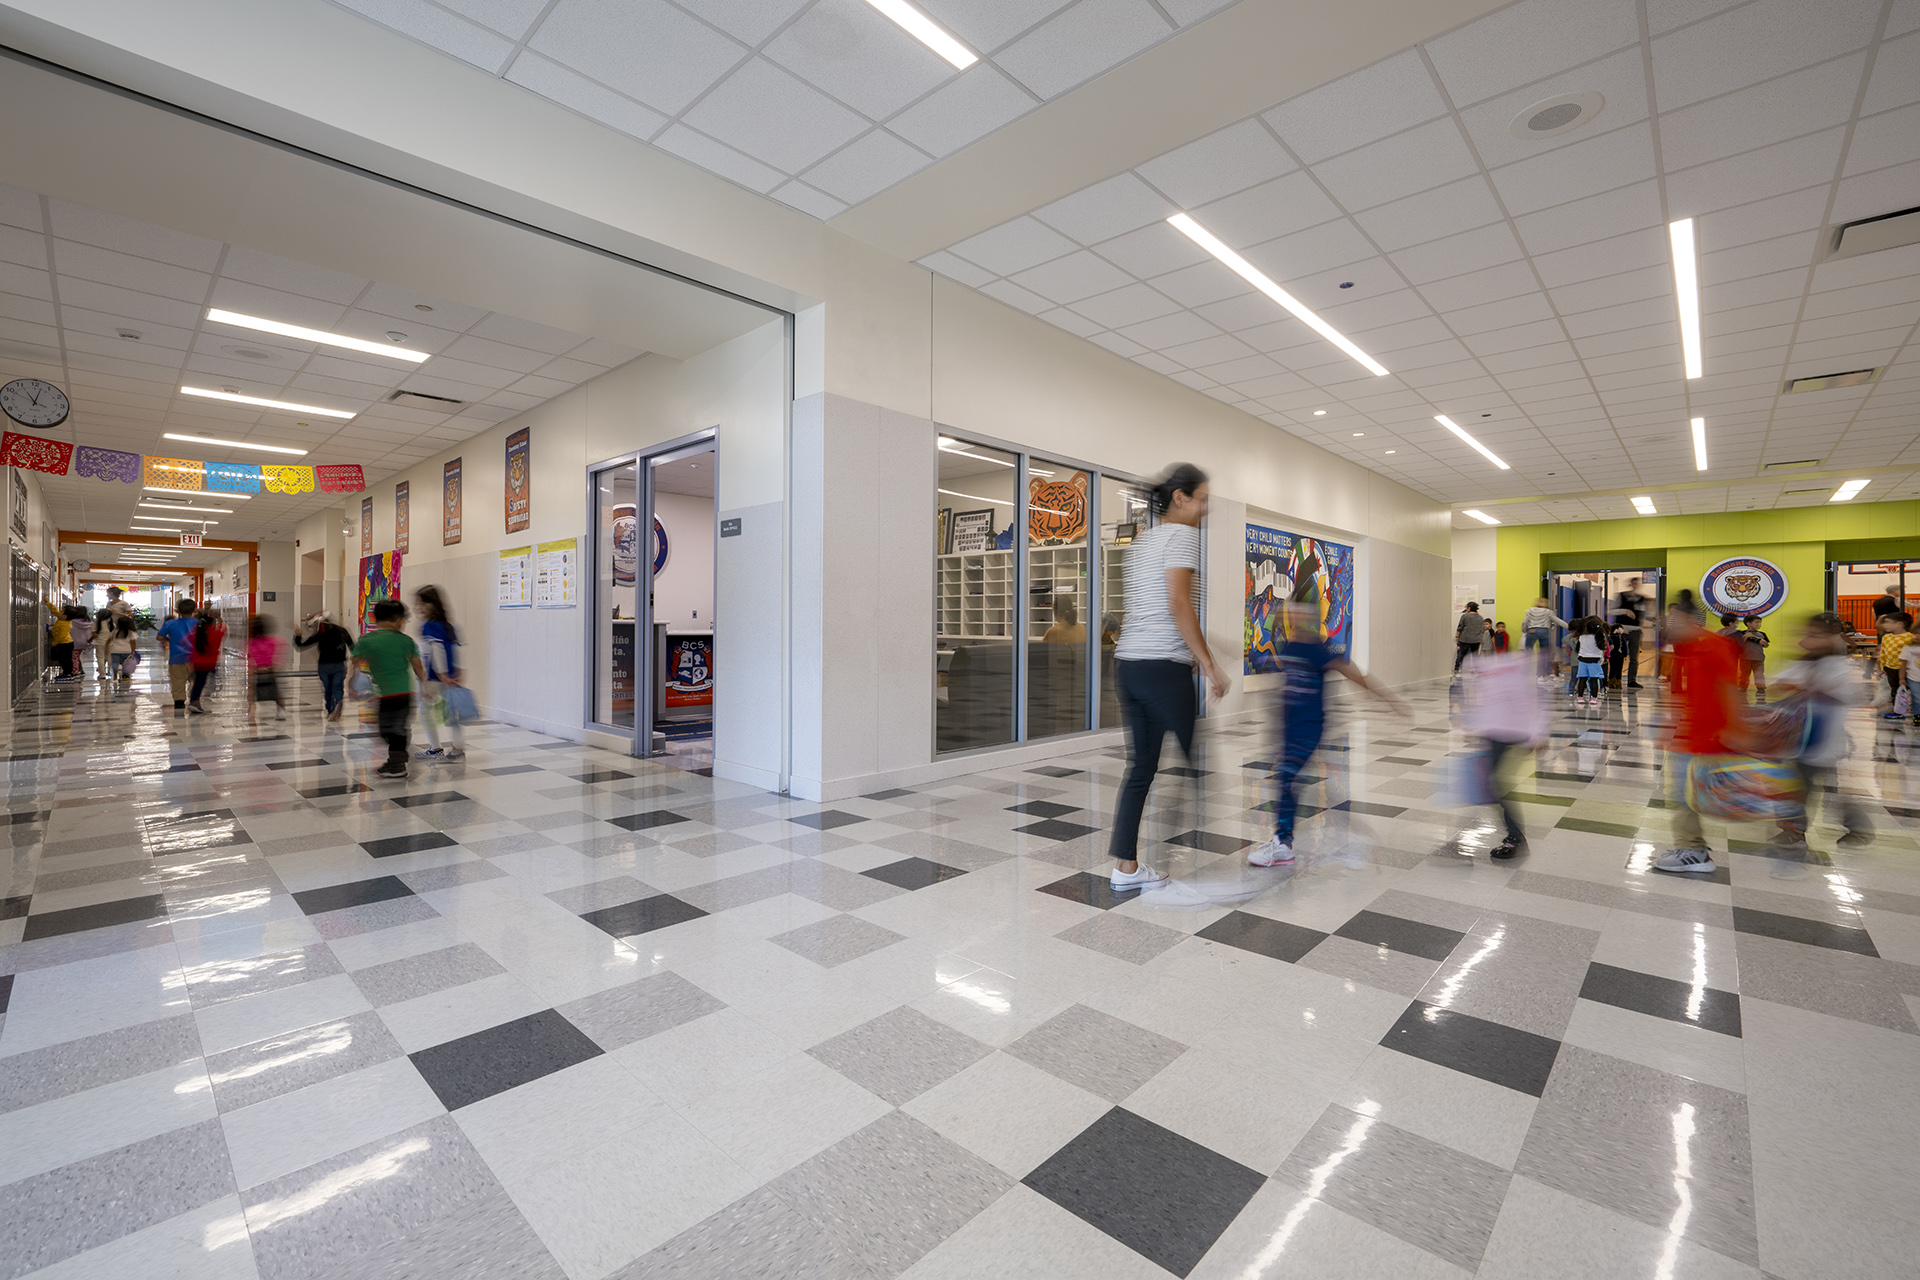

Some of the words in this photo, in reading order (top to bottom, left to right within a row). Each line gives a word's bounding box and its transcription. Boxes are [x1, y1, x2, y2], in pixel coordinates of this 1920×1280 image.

[182, 534, 200, 544] EXIT
[1246, 528, 1258, 541] VERY
[1259, 531, 1272, 543] CHILD
[1273, 533, 1292, 547] MATTERS
[1246, 541, 1259, 554] VERY
[1259, 544, 1277, 557] MOMENT
[1710, 560, 1775, 578] Belmont-Cragin
[1749, 602, 1772, 615] School
[682, 641, 705, 650] BCS
